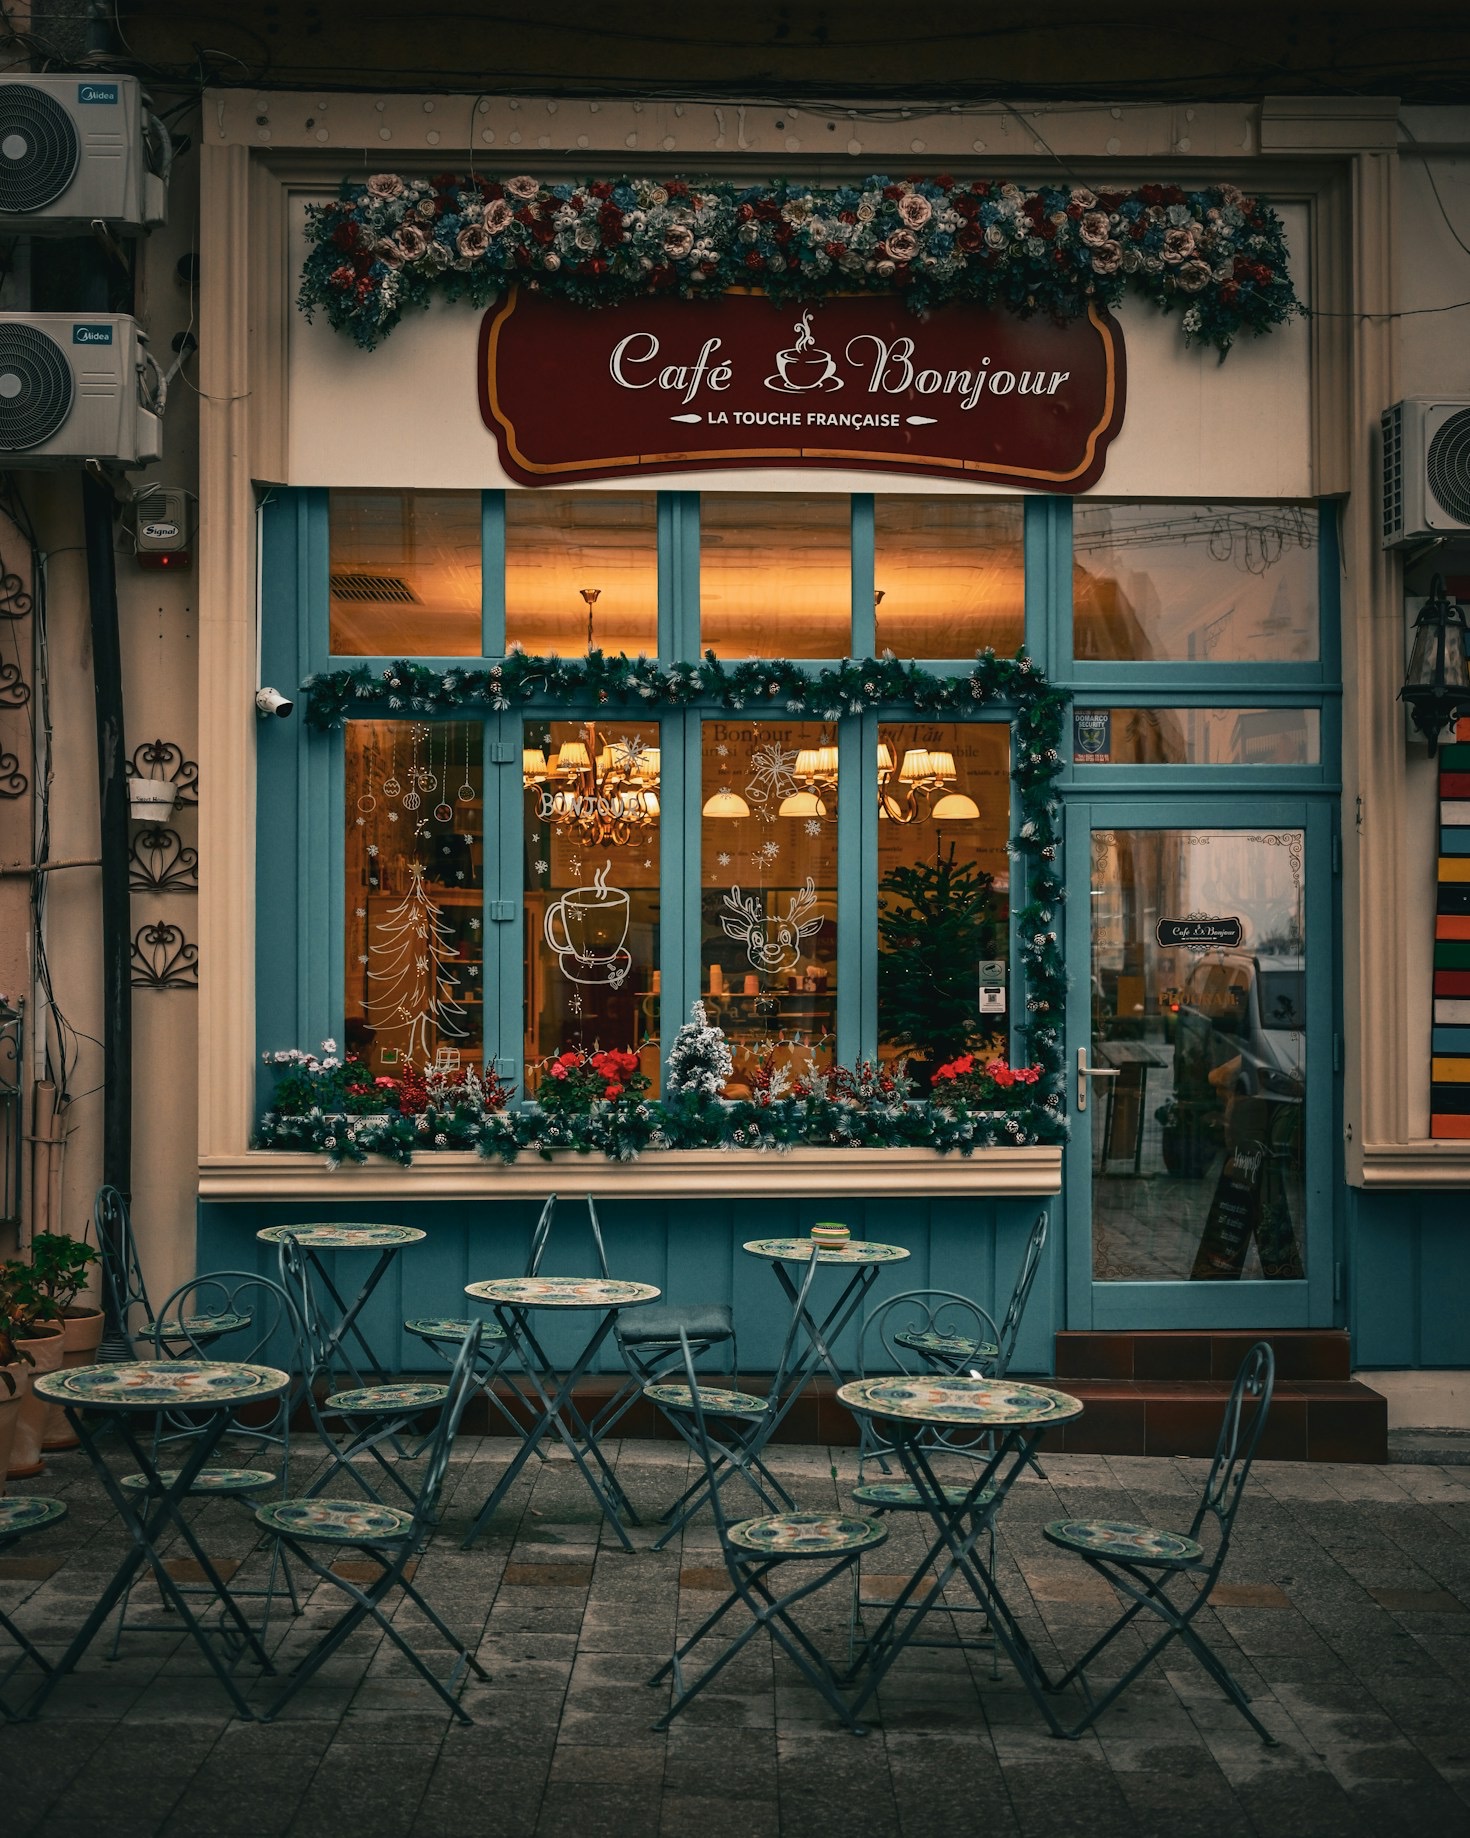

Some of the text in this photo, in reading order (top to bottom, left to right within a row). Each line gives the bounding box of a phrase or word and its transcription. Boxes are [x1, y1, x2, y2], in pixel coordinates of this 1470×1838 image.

[84, 90, 114, 100] Midea
[80, 331, 109, 341] Midea
[609, 332, 1070, 410] Café Bonjour
[708, 411, 900, 430] LA TOUCHE FRANÇAISE
[145, 526, 176, 537] Signal
[539, 792, 640, 819] BONJOUR
[1172, 926, 1236, 938] Café Bonjour
